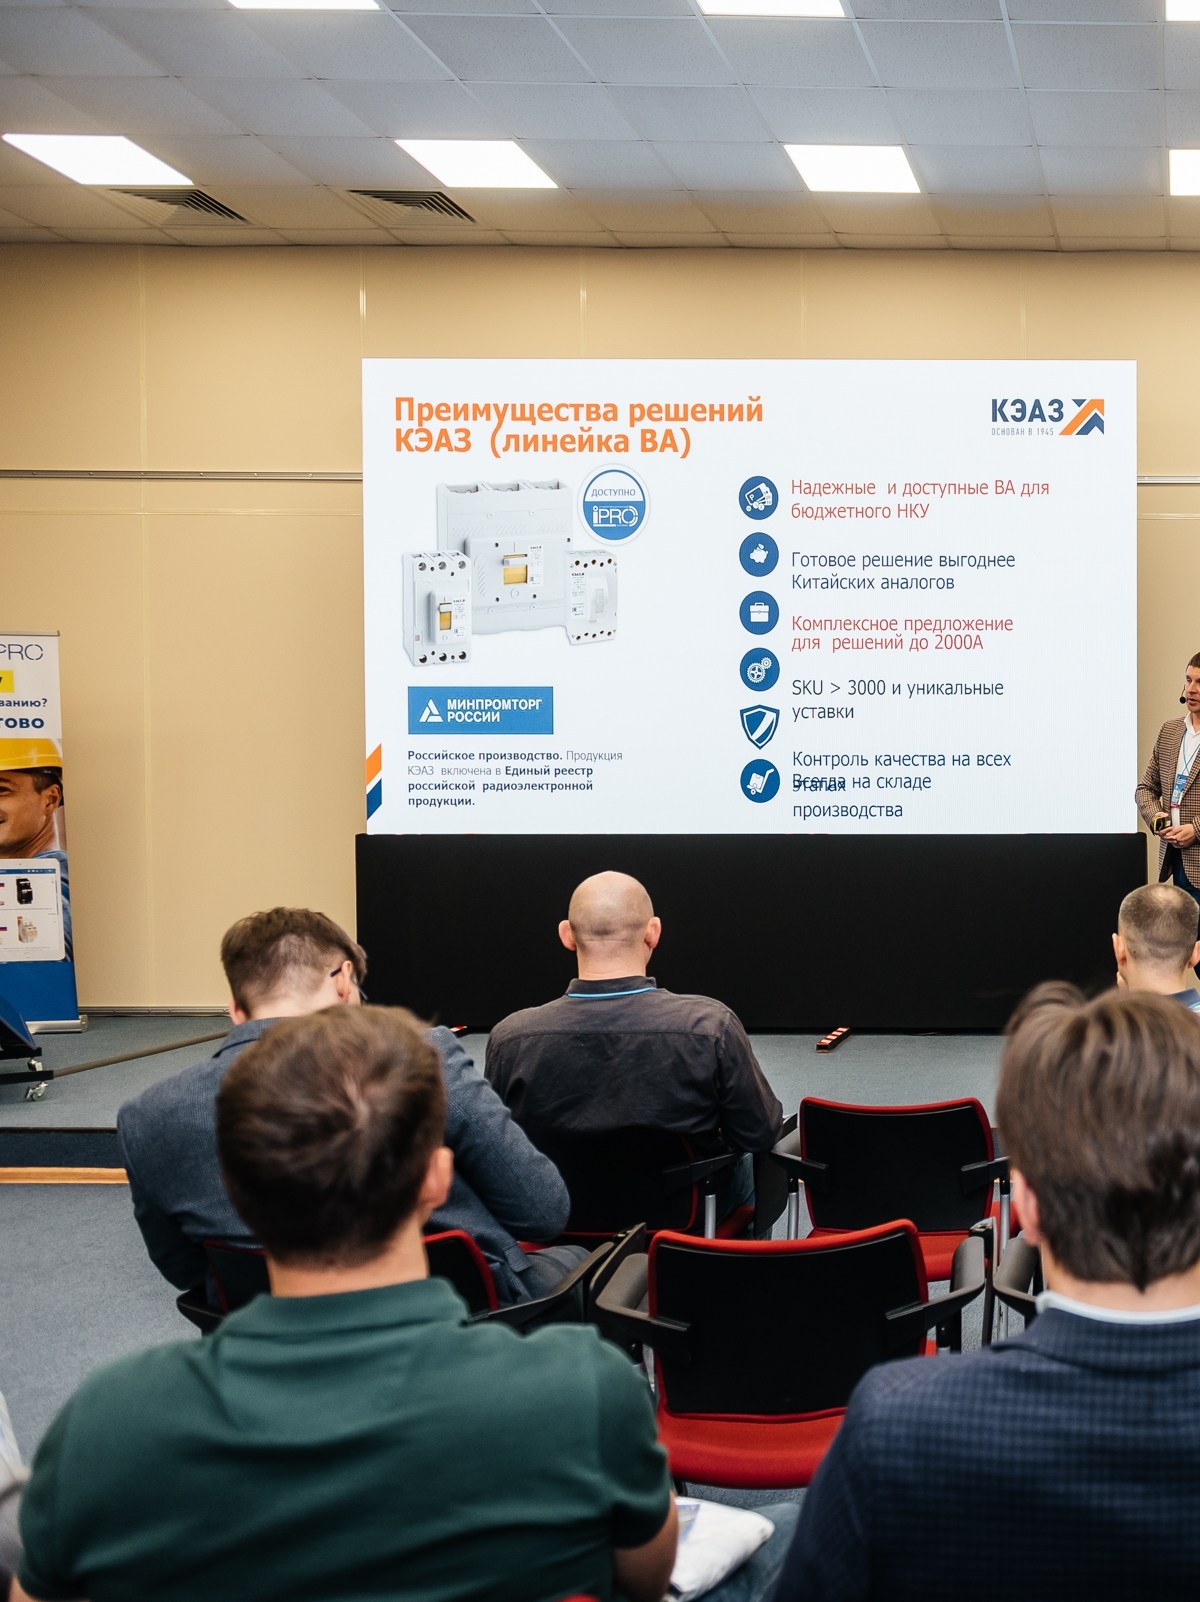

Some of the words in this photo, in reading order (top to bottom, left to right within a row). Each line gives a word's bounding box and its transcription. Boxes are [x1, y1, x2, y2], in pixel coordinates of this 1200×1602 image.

[396, 397, 618, 427] Преимущества
[630, 396, 762, 427] решений
[992, 399, 1063, 422] КЭАЗ
[991, 427, 1025, 436] ОСНОВАН
[1036, 427, 1054, 436] 1945
[396, 428, 471, 452] КЭАЗ
[491, 428, 629, 458] (линейка
[641, 428, 690, 459] ВА)
[591, 489, 635, 497] ДОСТУПНО
[792, 480, 875, 496] Надежные
[888, 483, 896, 494] и
[903, 483, 988, 498] доступные
[995, 480, 1015, 494] ВА
[1021, 483, 1049, 497] для
[792, 503, 891, 520] бюджетного
[898, 504, 929, 518] НКУ
[793, 552, 855, 567] Готовое
[863, 555, 932, 570] решение
[940, 555, 1015, 569] выгоднее
[793, 573, 874, 589] Китайских
[881, 578, 954, 589] аналогов
[793, 616, 898, 631] Комплексное
[905, 619, 1013, 635] предложение
[792, 638, 820, 652] для
[833, 634, 903, 653] решений
[909, 637, 928, 652] до
[793, 680, 822, 695] SKU
[831, 683, 840, 693] >
[848, 680, 885, 695] 3000
[893, 684, 900, 695] и
[907, 683, 1003, 698] уникальные
[447, 699, 542, 710] МИНПРОМТОРГ
[447, 711, 501, 722] РОССИИ
[792, 707, 853, 722] уставки
[408, 750, 474, 760] Российское
[479, 752, 562, 762] производство.
[567, 751, 622, 762] Продукция
[794, 752, 868, 768] Контроль
[875, 755, 945, 766] качества
[953, 755, 970, 766] на
[977, 755, 1011, 766] всех
[408, 766, 434, 775] КЭАЗ
[506, 765, 550, 776] Единый
[555, 768, 593, 777] реестр
[409, 780, 475, 792] российской
[483, 780, 592, 792] радиоэлектронной
[853, 777, 870, 788] на
[877, 777, 931, 791] складе
[409, 798, 474, 808] продукции.
[794, 804, 902, 820] производства
